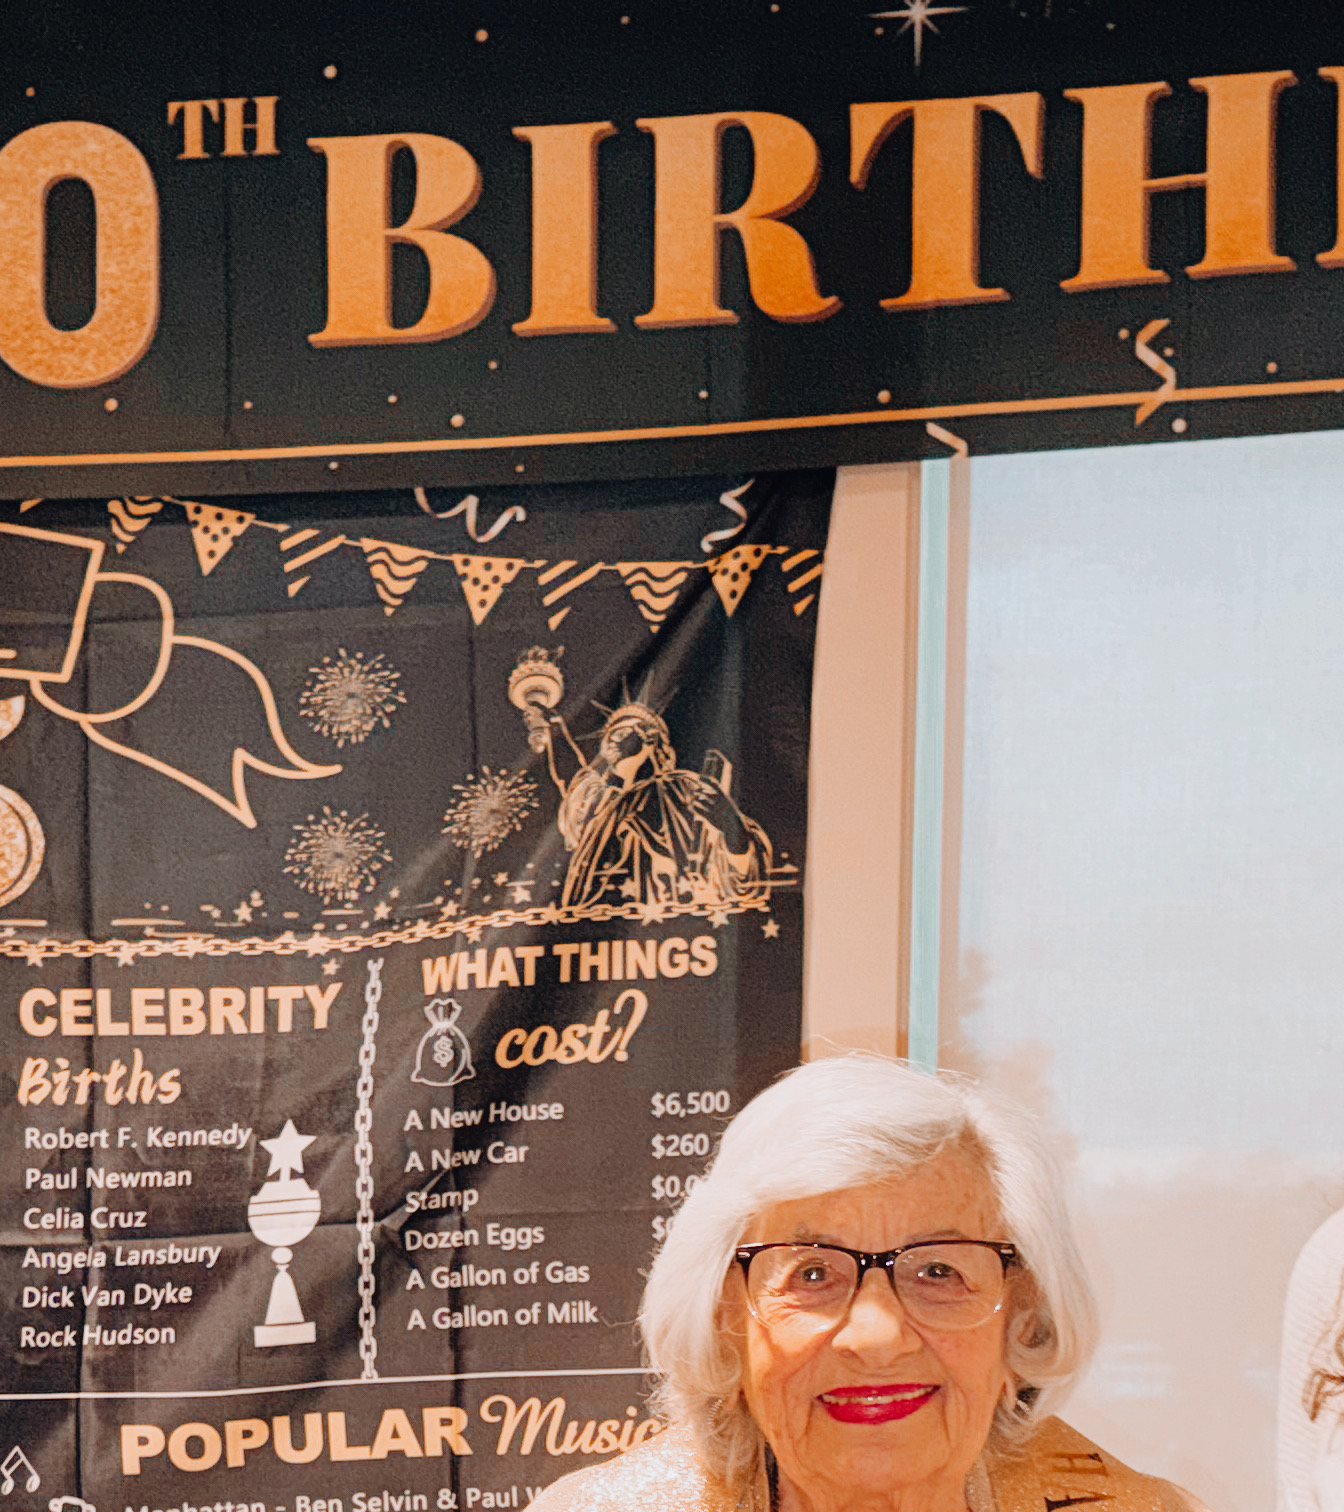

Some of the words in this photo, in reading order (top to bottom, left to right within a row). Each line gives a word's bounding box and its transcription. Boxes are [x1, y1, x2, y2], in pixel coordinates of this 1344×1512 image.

[421, 944, 545, 996] WHAT
[553, 935, 718, 983] THINGS
[19, 981, 343, 1037] CELEBRITY
[494, 988, 648, 1069] cost?
[17, 1047, 182, 1107] Births
[403, 1109, 424, 1132] A
[430, 1105, 482, 1129] New
[489, 1102, 564, 1124] House
[650, 1089, 731, 1119] $6,500
[24, 1126, 108, 1149] Robert
[117, 1126, 139, 1149] F.
[146, 1122, 254, 1151] Kennedy
[404, 1150, 424, 1173] A
[431, 1147, 480, 1170] New
[486, 1141, 530, 1164] Car
[650, 1132, 709, 1159] $260
[25, 1167, 78, 1190] Paul
[85, 1167, 192, 1189] Newman
[23, 1206, 85, 1230] Celia
[90, 1206, 147, 1229] Cruz
[404, 1227, 480, 1252] Dozen
[486, 1222, 545, 1251] Eggs
[21, 1246, 107, 1275] Angela
[114, 1244, 223, 1269] Lansbury
[405, 1268, 425, 1292] A
[431, 1264, 507, 1290] Gallon
[514, 1262, 541, 1285] of
[545, 1260, 591, 1283] Gas
[22, 1286, 75, 1308] Dick
[81, 1287, 125, 1308] Van
[134, 1282, 193, 1311] Dyke
[407, 1308, 427, 1331] A
[432, 1304, 508, 1331] Gallon
[514, 1302, 542, 1326] of
[547, 1299, 600, 1324] Milk
[20, 1325, 77, 1349] Rock
[82, 1323, 176, 1347] Hudson
[120, 1406, 473, 1477] POPULAR
